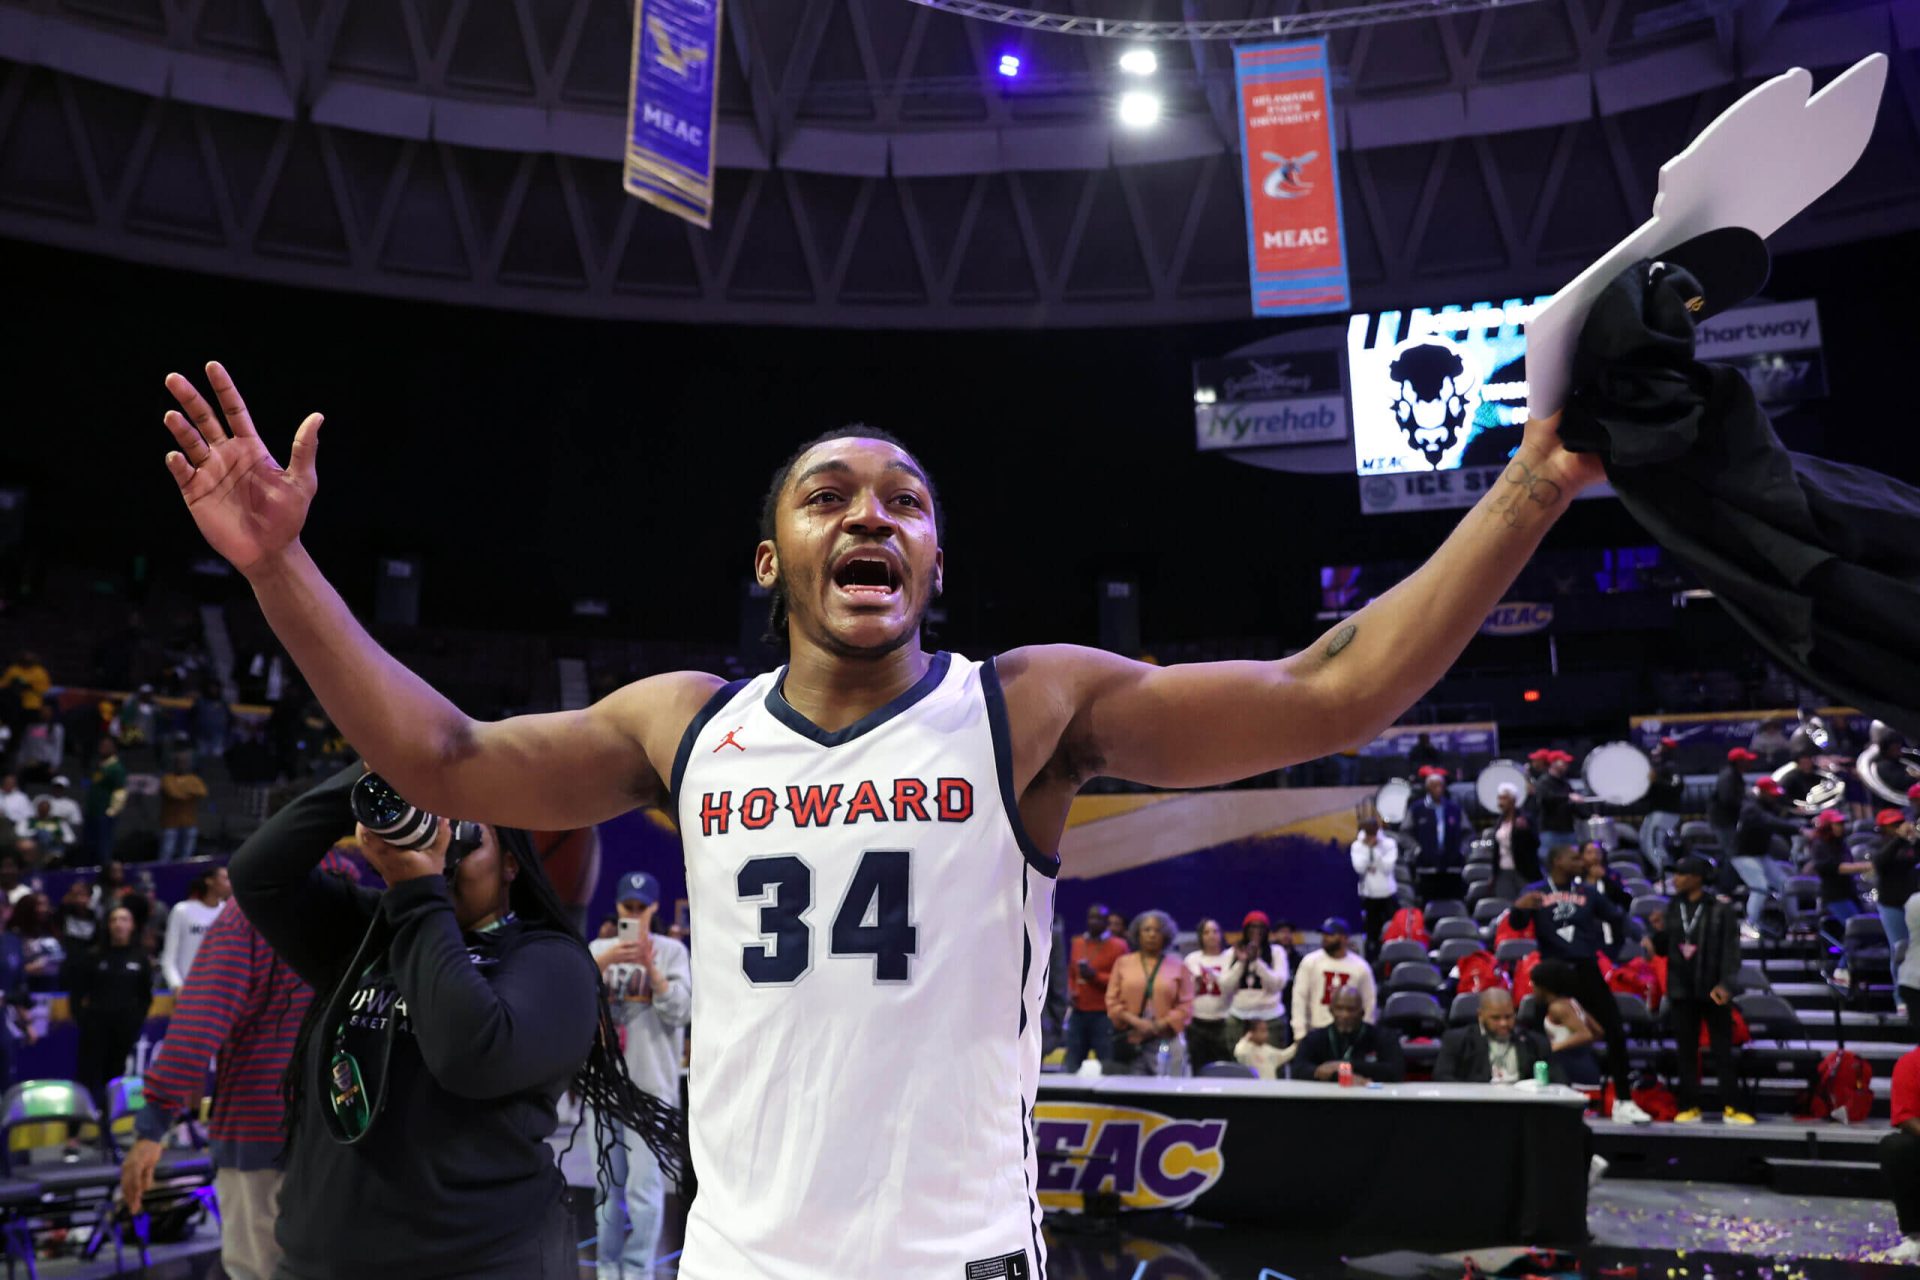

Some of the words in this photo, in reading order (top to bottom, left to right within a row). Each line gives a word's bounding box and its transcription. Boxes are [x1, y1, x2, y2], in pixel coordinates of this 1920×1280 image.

[642, 102, 704, 147] MEAC
[1263, 226, 1328, 249] MEAC
[1405, 474, 1455, 496] ICE
[699, 777, 974, 837] HOWARD
[733, 847, 922, 988] 34
[1034, 1119, 1229, 1200] EAC
[1013, 1262, 1022, 1277] L
